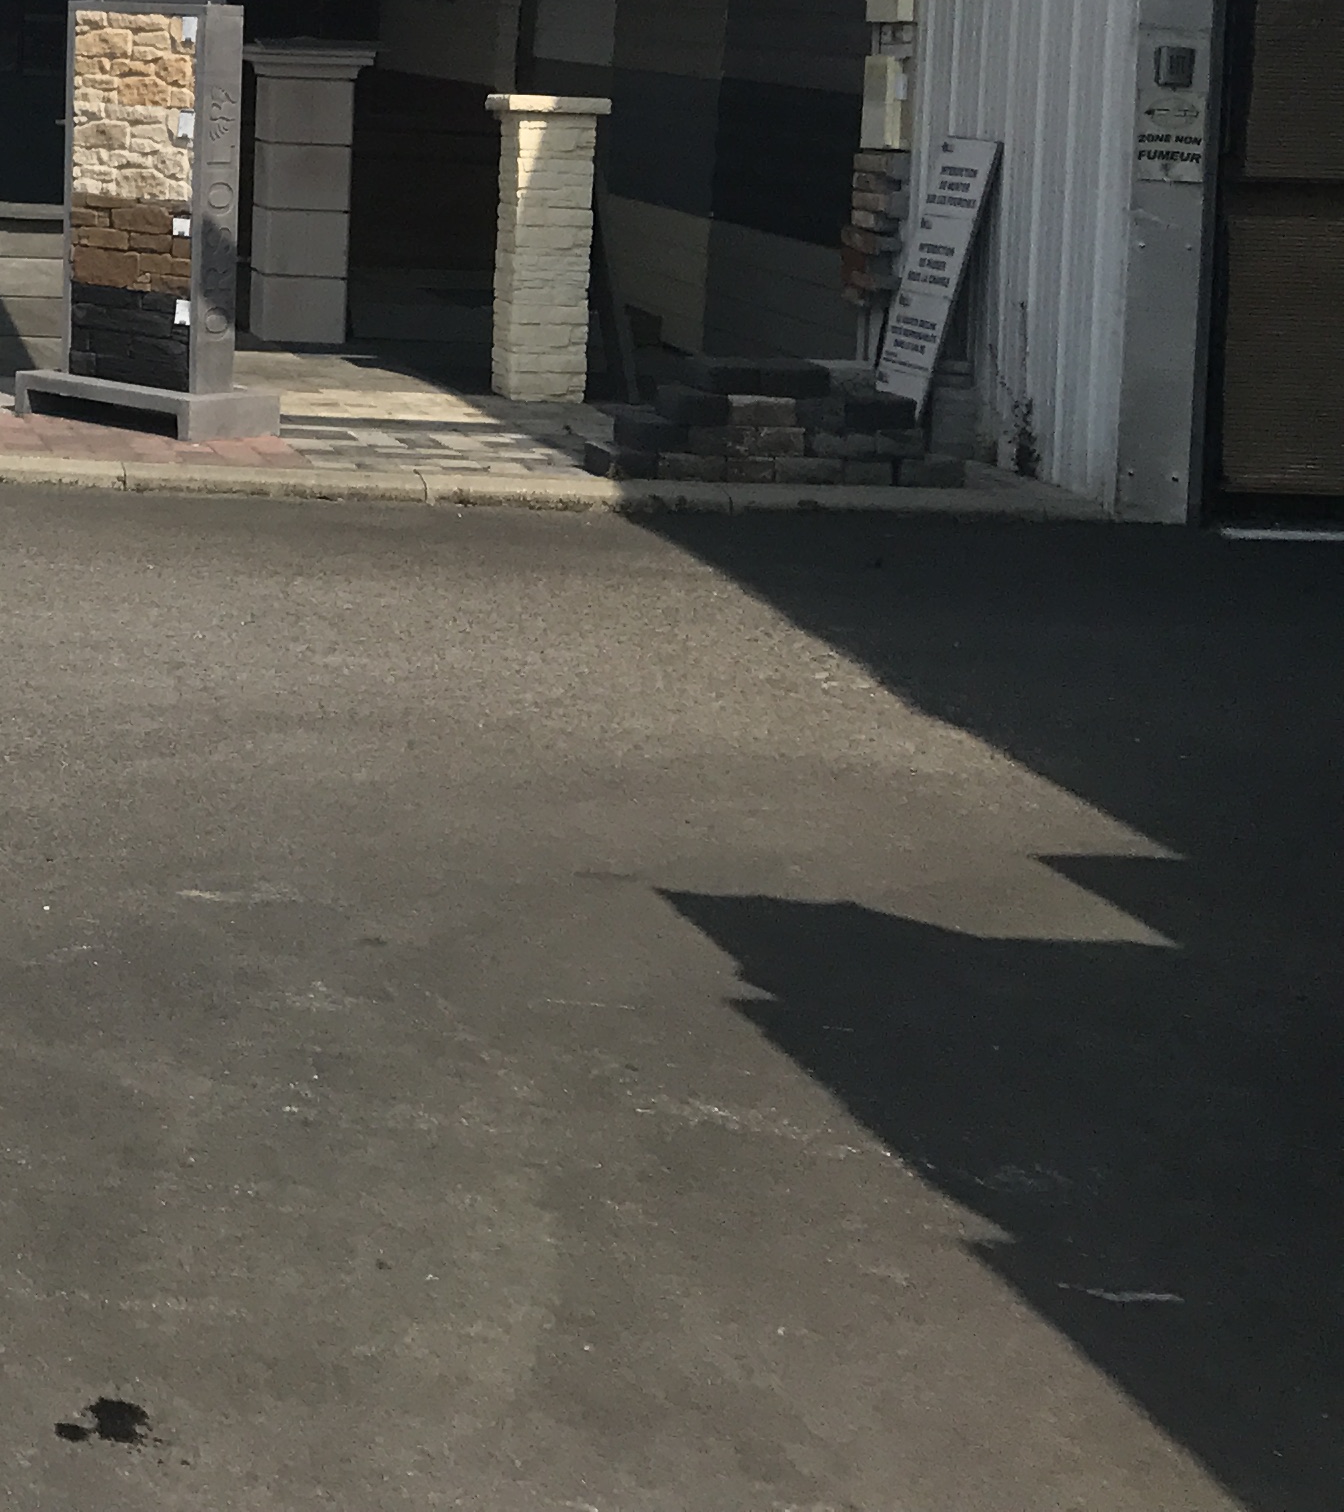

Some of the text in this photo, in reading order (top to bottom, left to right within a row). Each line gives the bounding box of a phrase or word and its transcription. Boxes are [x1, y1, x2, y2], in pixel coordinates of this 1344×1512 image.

[1137, 133, 1202, 146] ZONE NON
[1137, 149, 1202, 164] FUMEUR
